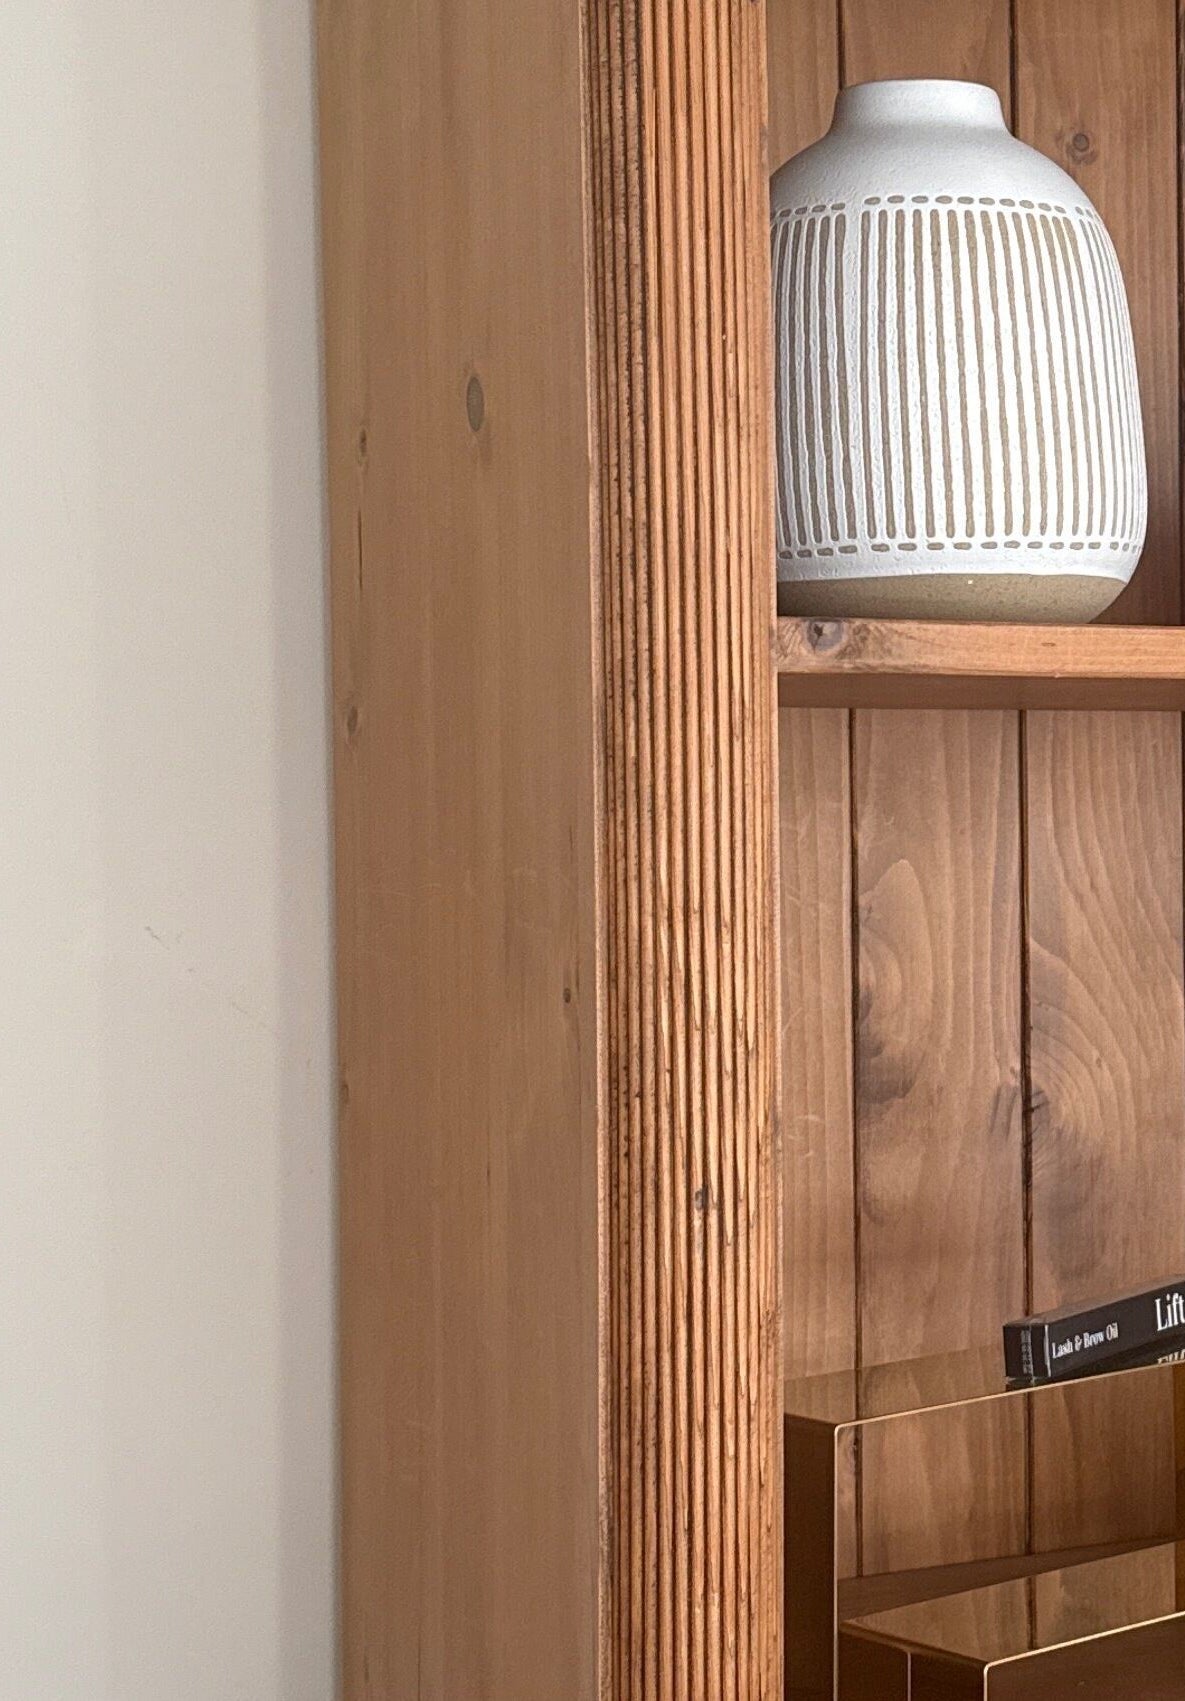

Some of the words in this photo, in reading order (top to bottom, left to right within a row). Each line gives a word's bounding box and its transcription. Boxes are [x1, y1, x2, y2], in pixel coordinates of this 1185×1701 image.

[1052, 1338, 1074, 1359] Lash
[1075, 1335, 1083, 1351] &
[1083, 1331, 1105, 1349] Brow
[1106, 1322, 1119, 1341] Oil
